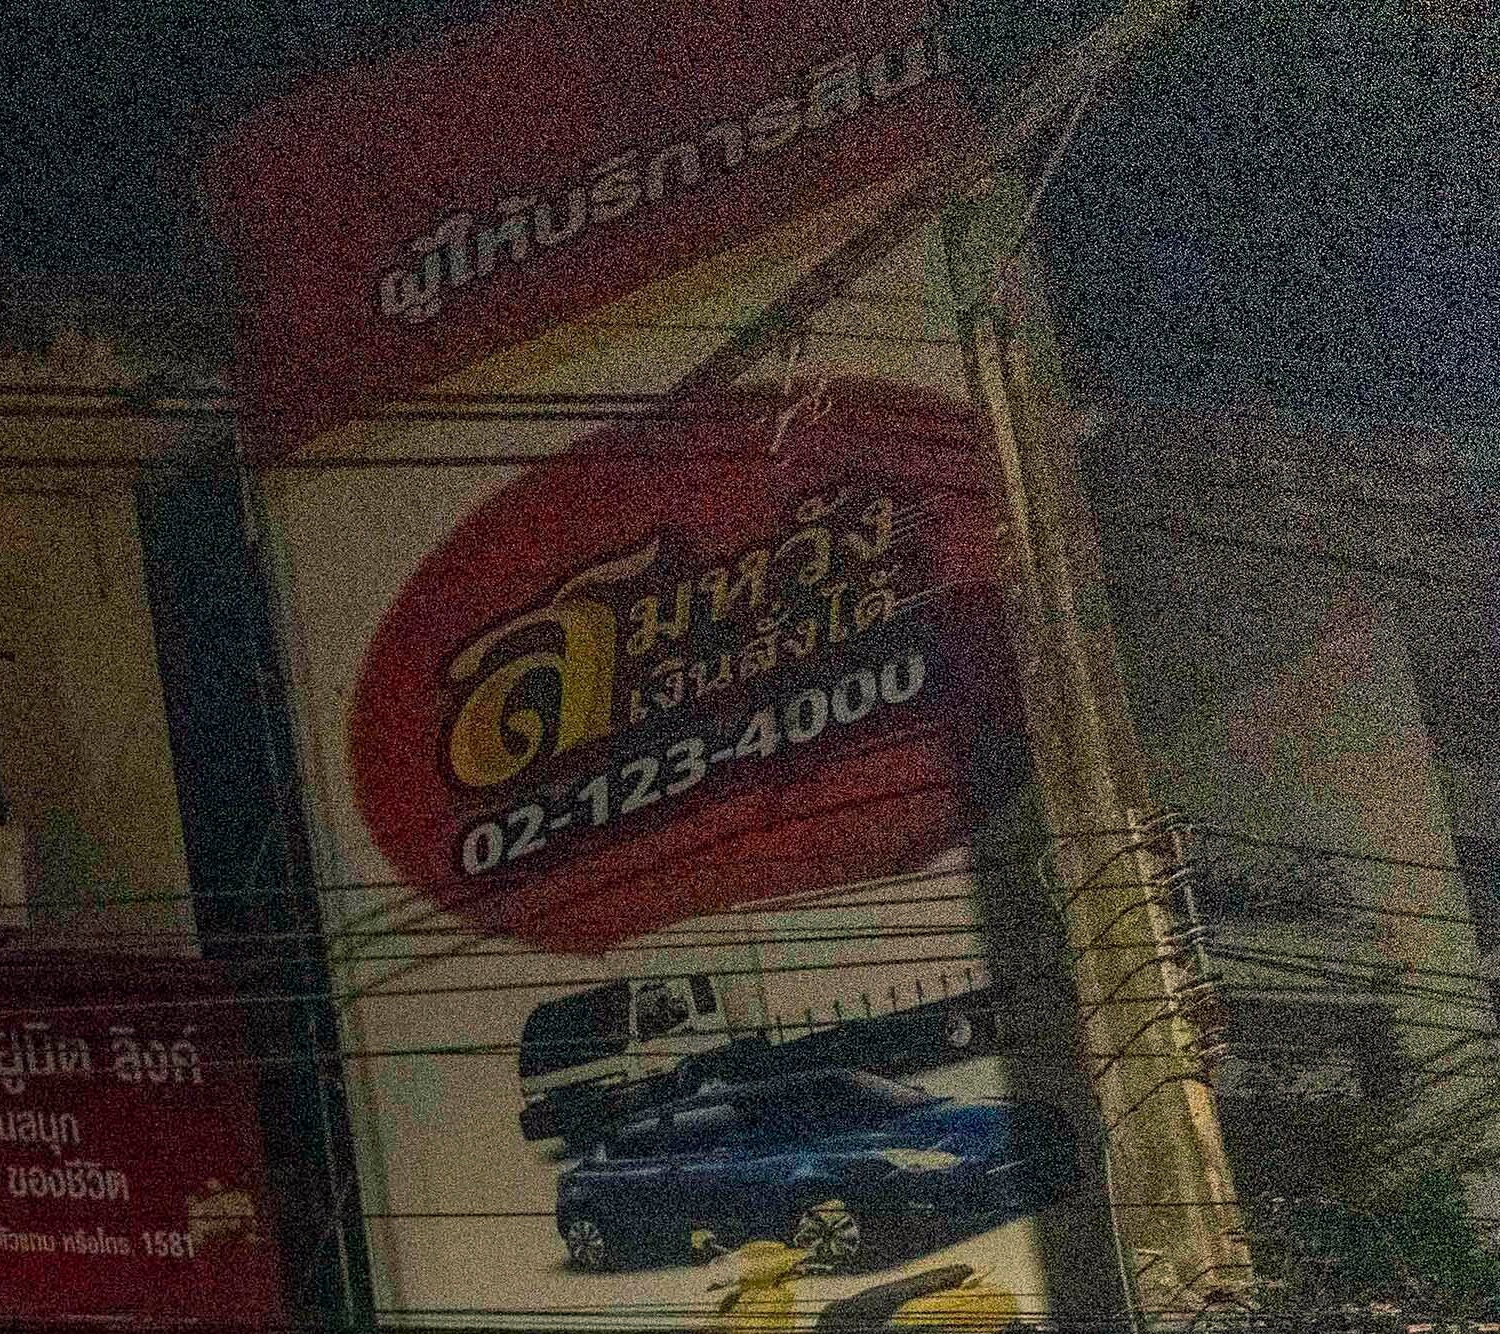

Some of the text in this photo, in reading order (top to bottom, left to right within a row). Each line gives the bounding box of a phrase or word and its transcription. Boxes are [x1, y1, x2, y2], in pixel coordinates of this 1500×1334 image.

[461, 652, 927, 877] 02-123-4000
[6, 1157, 130, 1202] ของชีวิต
[141, 1230, 199, 1260] 1581
